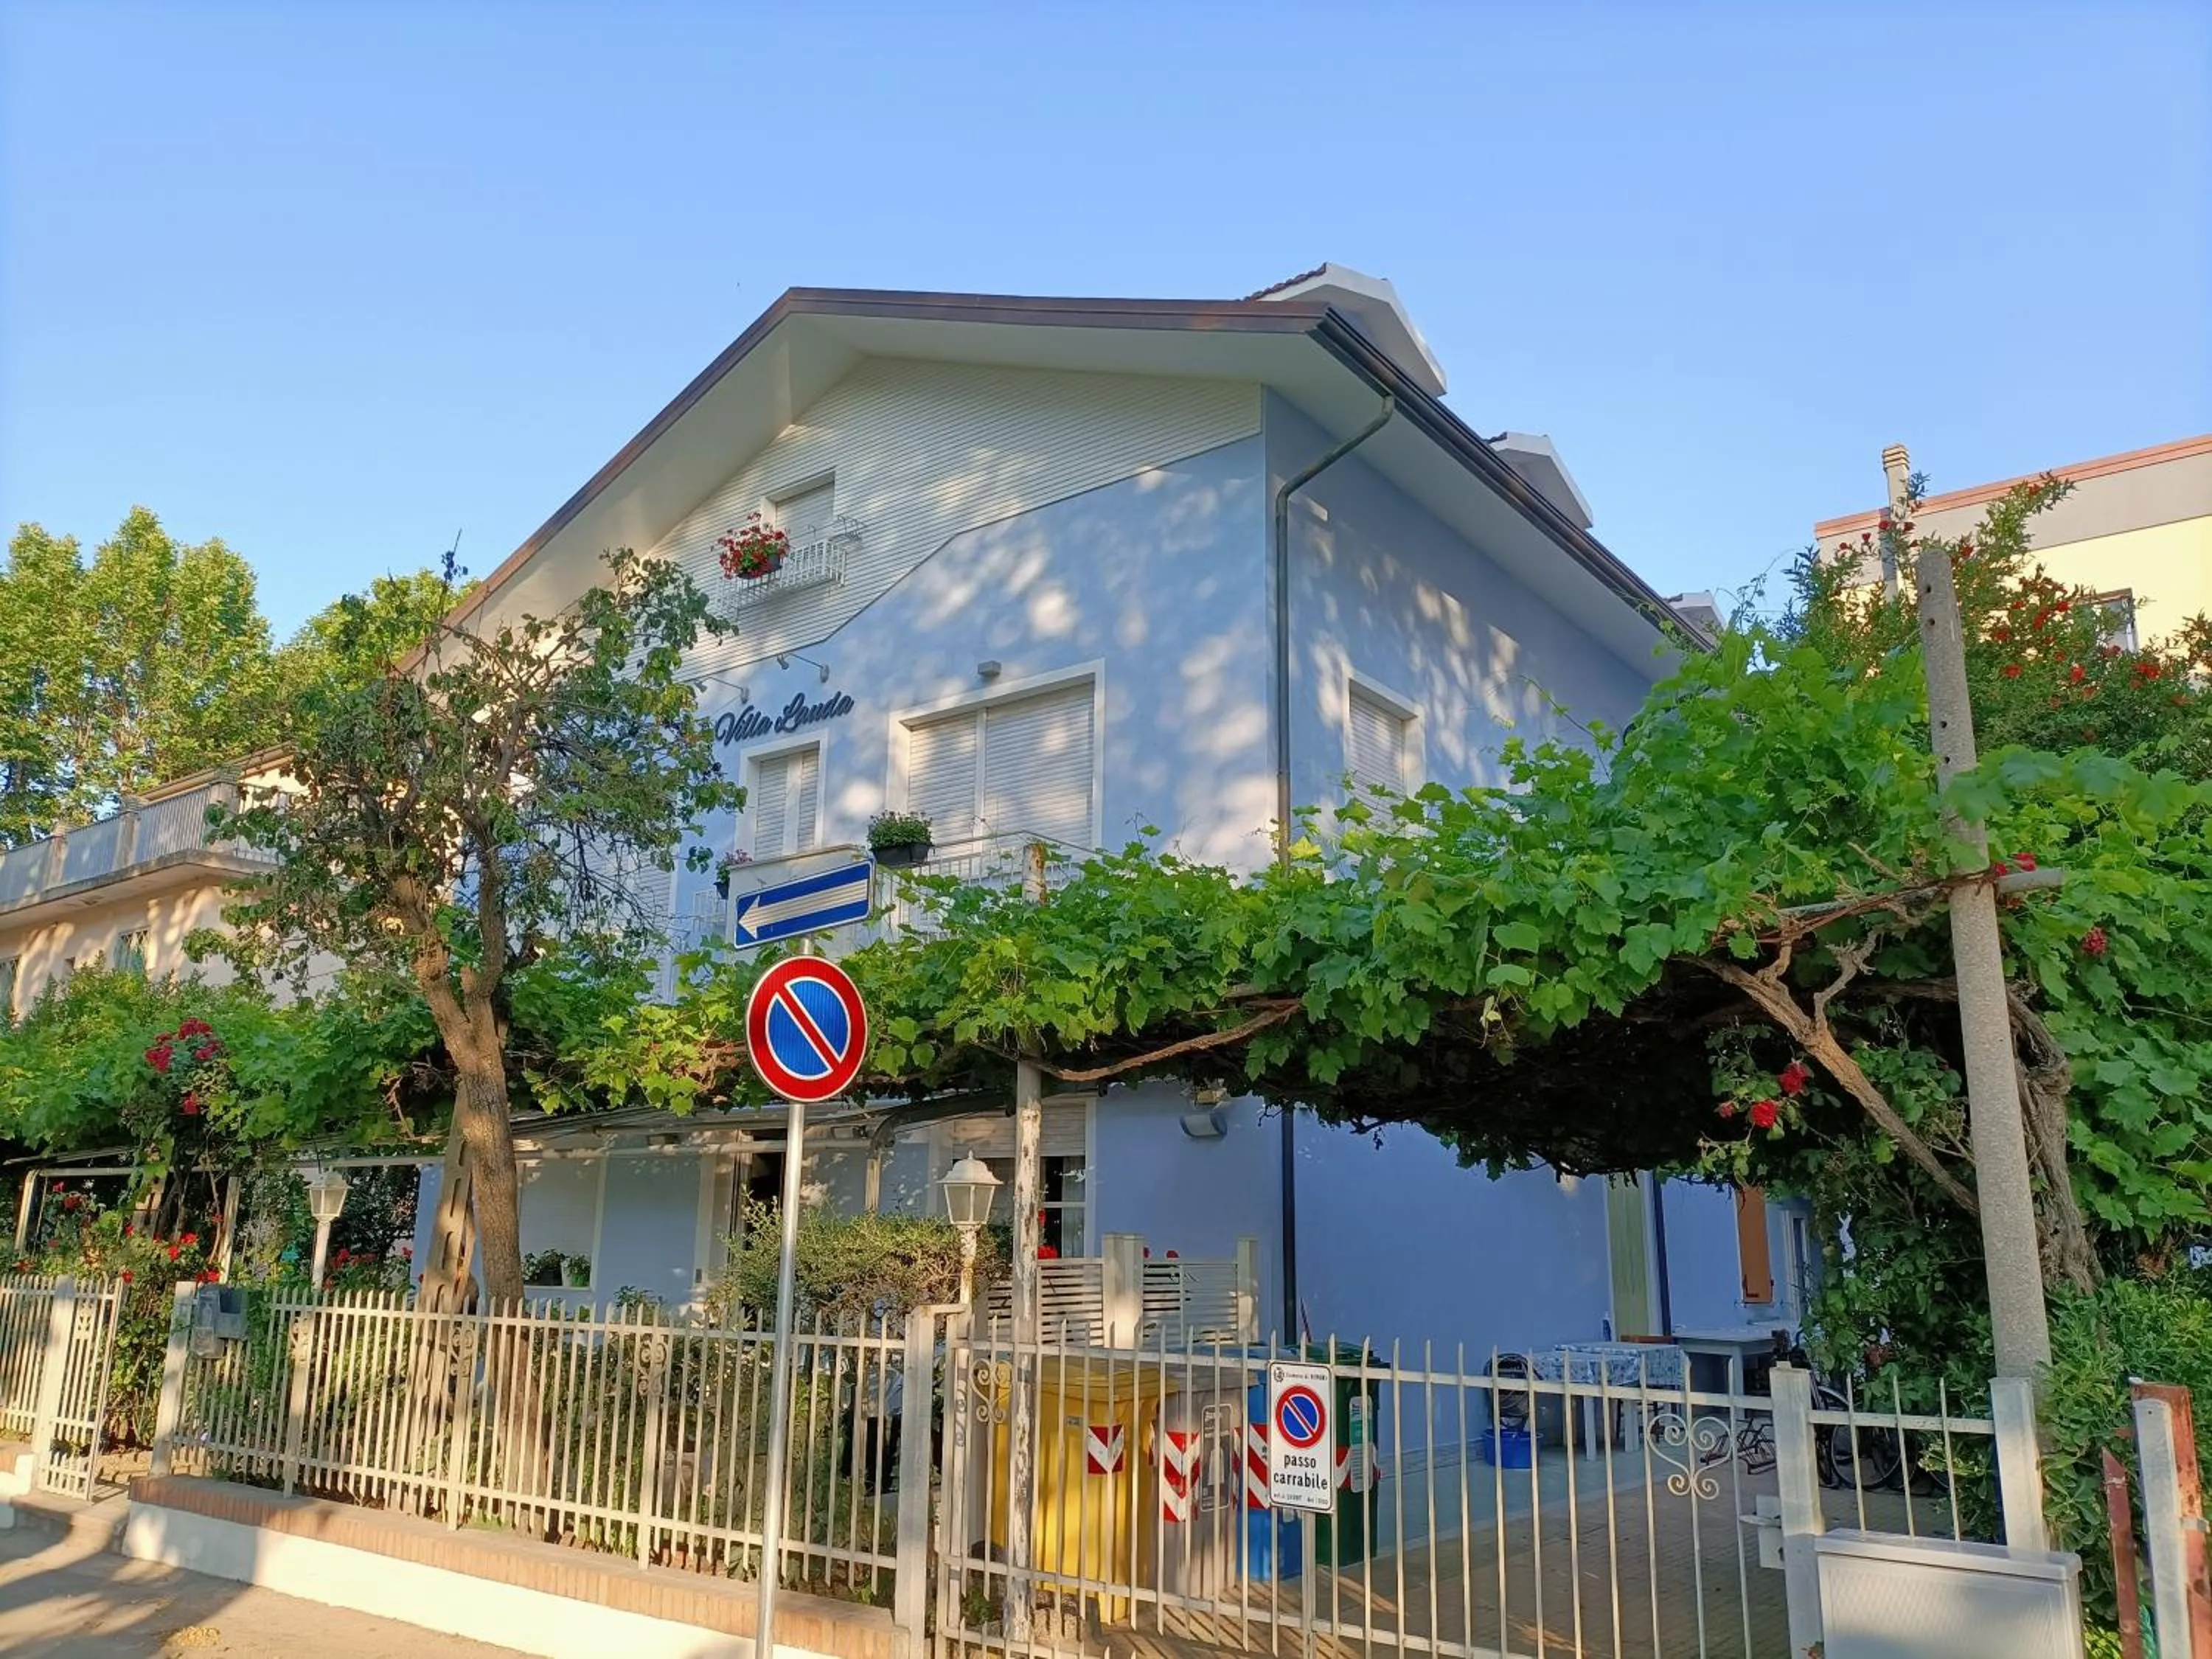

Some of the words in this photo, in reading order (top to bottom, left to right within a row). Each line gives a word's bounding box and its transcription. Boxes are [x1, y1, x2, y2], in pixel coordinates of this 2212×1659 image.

[714, 705, 773, 746] Villa
[773, 691, 855, 733] Lauda
[1284, 1454, 1316, 1469] passo
[1273, 1472, 1328, 1489] carrabile
